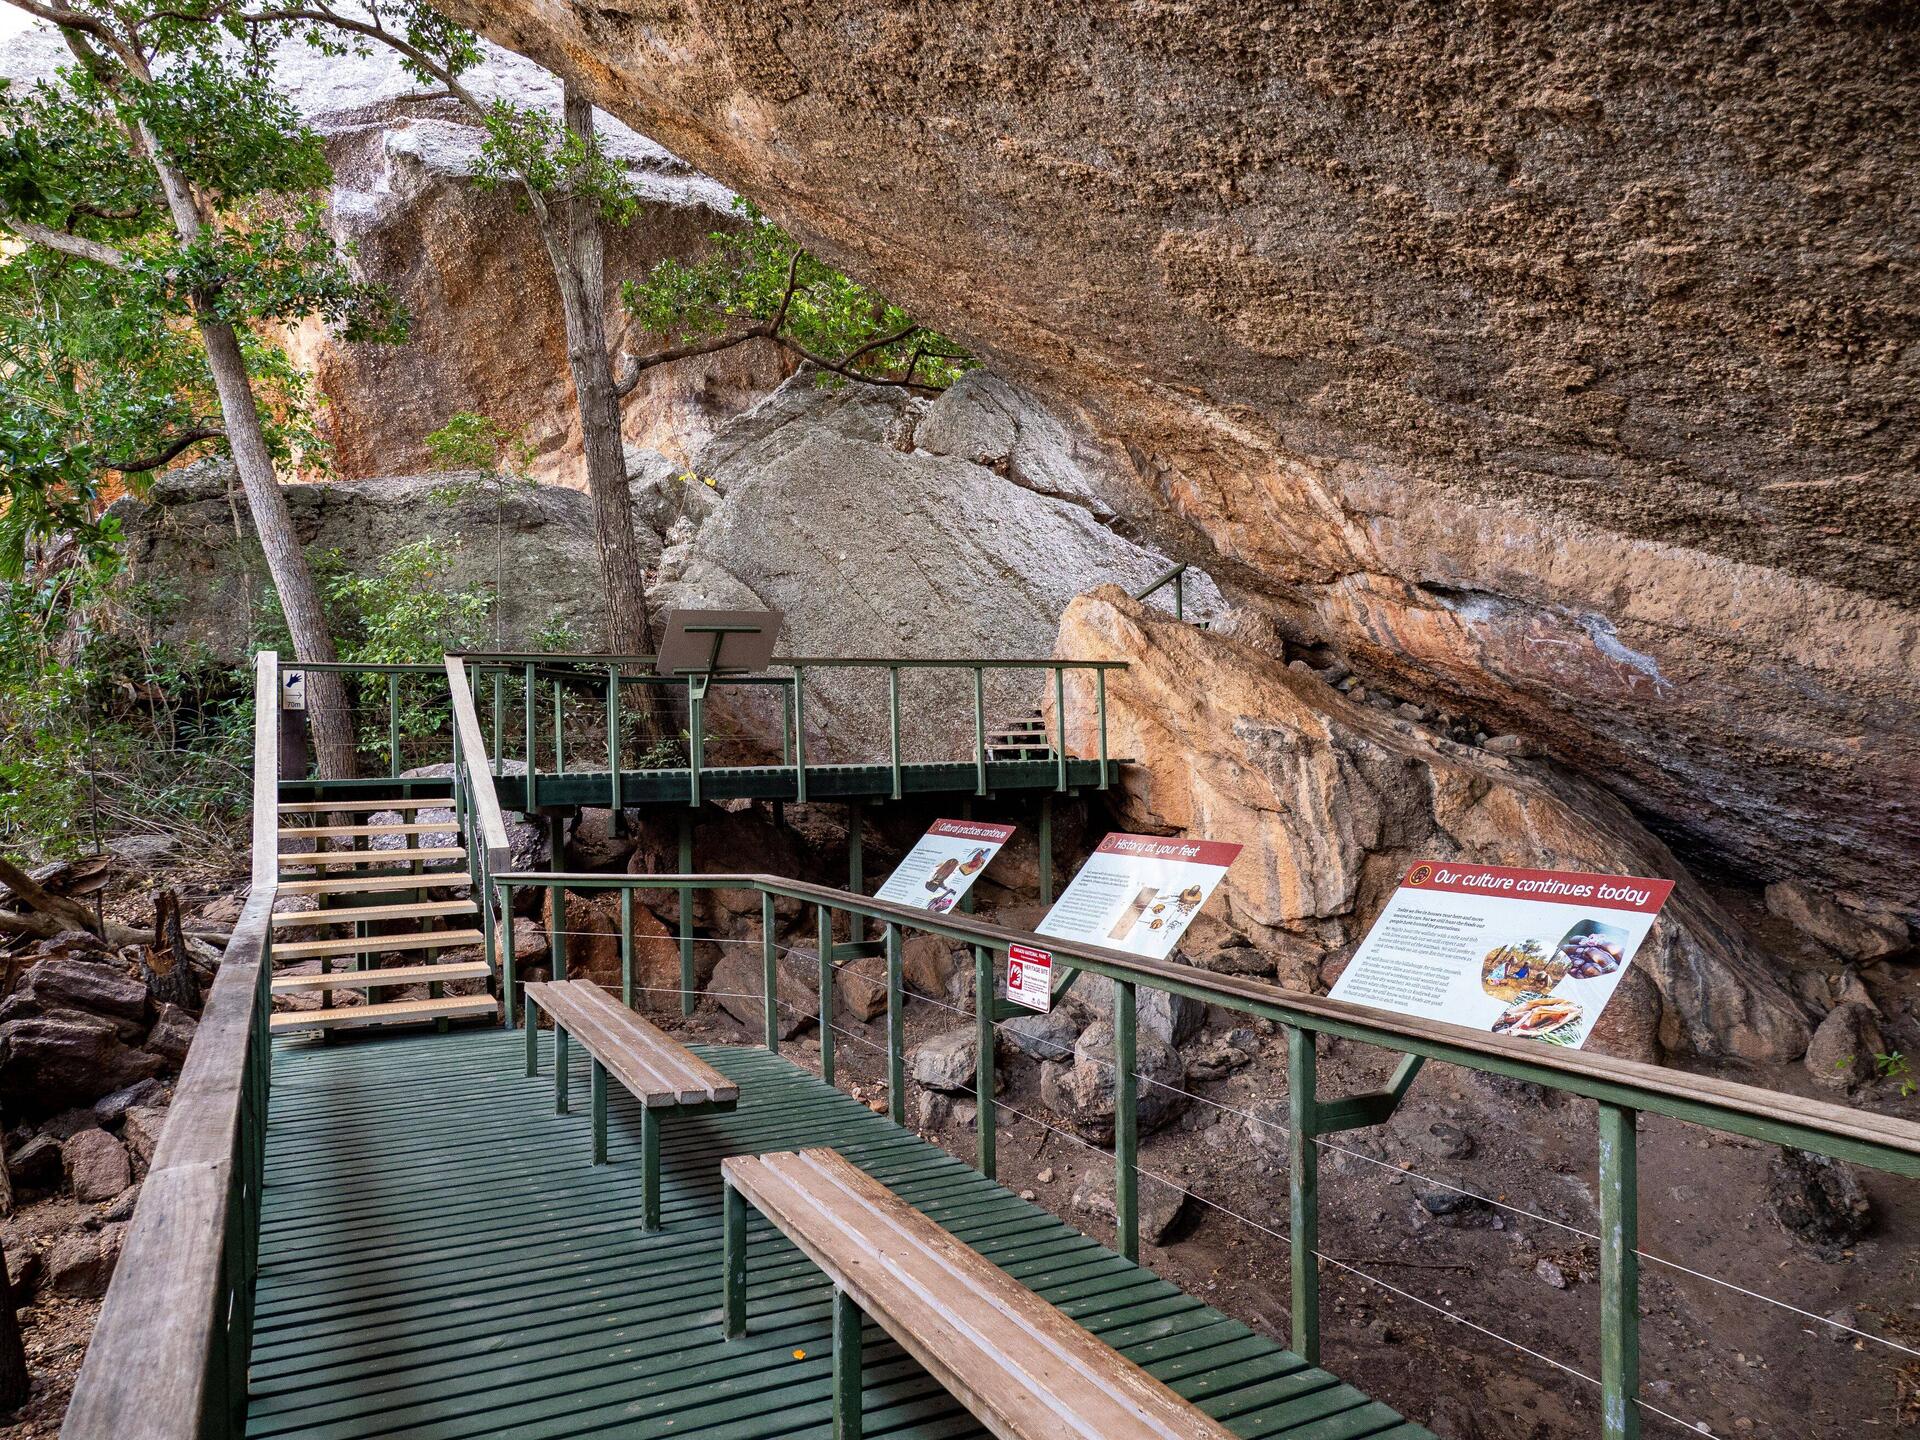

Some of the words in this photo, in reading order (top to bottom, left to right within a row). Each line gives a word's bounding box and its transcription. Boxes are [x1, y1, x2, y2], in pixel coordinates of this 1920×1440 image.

[939, 822, 959, 832] Cultural
[956, 825, 981, 835] practices
[981, 828, 1006, 838] continue
[1114, 838, 1144, 852] History
[1145, 841, 1158, 852] at
[1155, 845, 1179, 855] your
[1178, 844, 1200, 857] feet
[1434, 869, 1463, 884] Our
[1461, 871, 1513, 890] culture
[1516, 878, 1594, 898] continues
[1597, 883, 1651, 906] today
